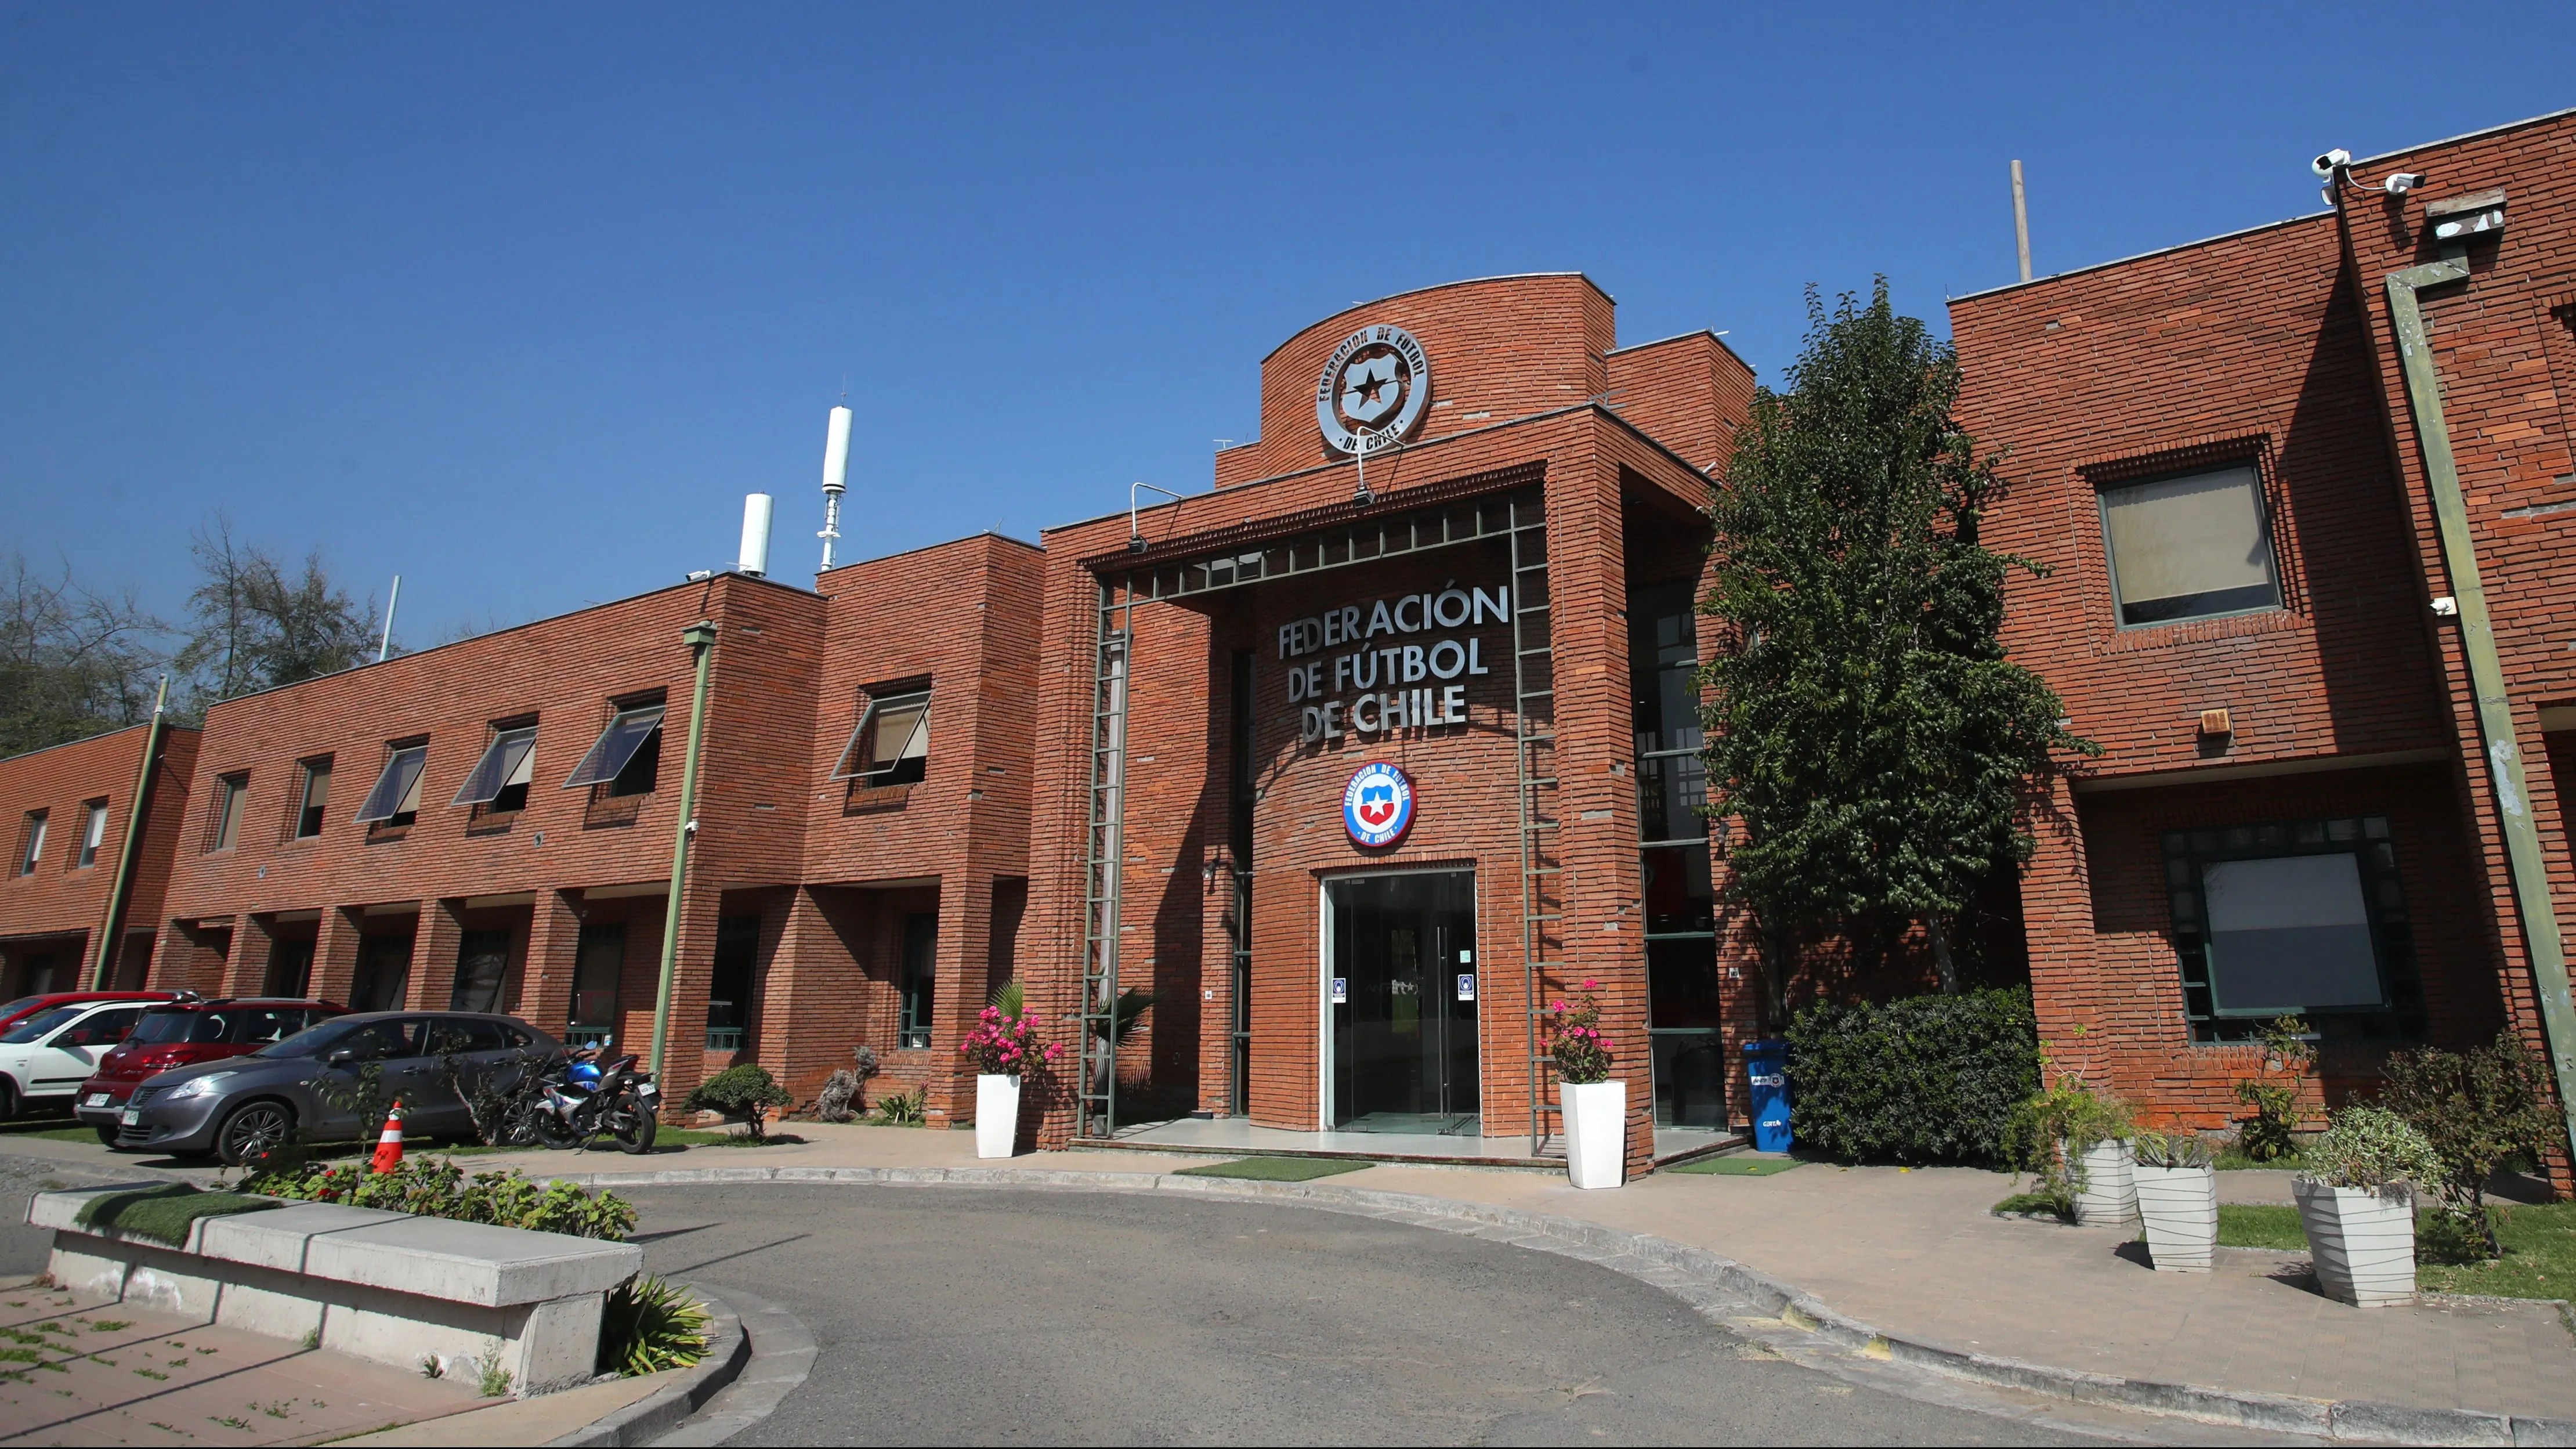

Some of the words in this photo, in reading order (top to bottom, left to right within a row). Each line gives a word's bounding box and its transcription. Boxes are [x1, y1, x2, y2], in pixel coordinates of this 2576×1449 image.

[1319, 330, 1367, 402] FEDERACION
[1377, 327, 1392, 341] DE
[1395, 333, 1425, 378] FUTBOL
[1343, 436, 1358, 451] DE
[1366, 424, 1401, 450] CHILE
[1278, 579, 1509, 660] FEDERACIÓN
[1288, 660, 1322, 703] DE
[1335, 637, 1489, 693] FÚTBOL
[1302, 700, 1344, 743] DE
[1353, 685, 1466, 733] CHILE
[1344, 764, 1377, 807] FEDERACION
[1381, 764, 1391, 774] DE
[1392, 770, 1410, 801] FUTBOL
[1360, 832, 1371, 843] DE
[1374, 828, 1396, 844] CHILE
